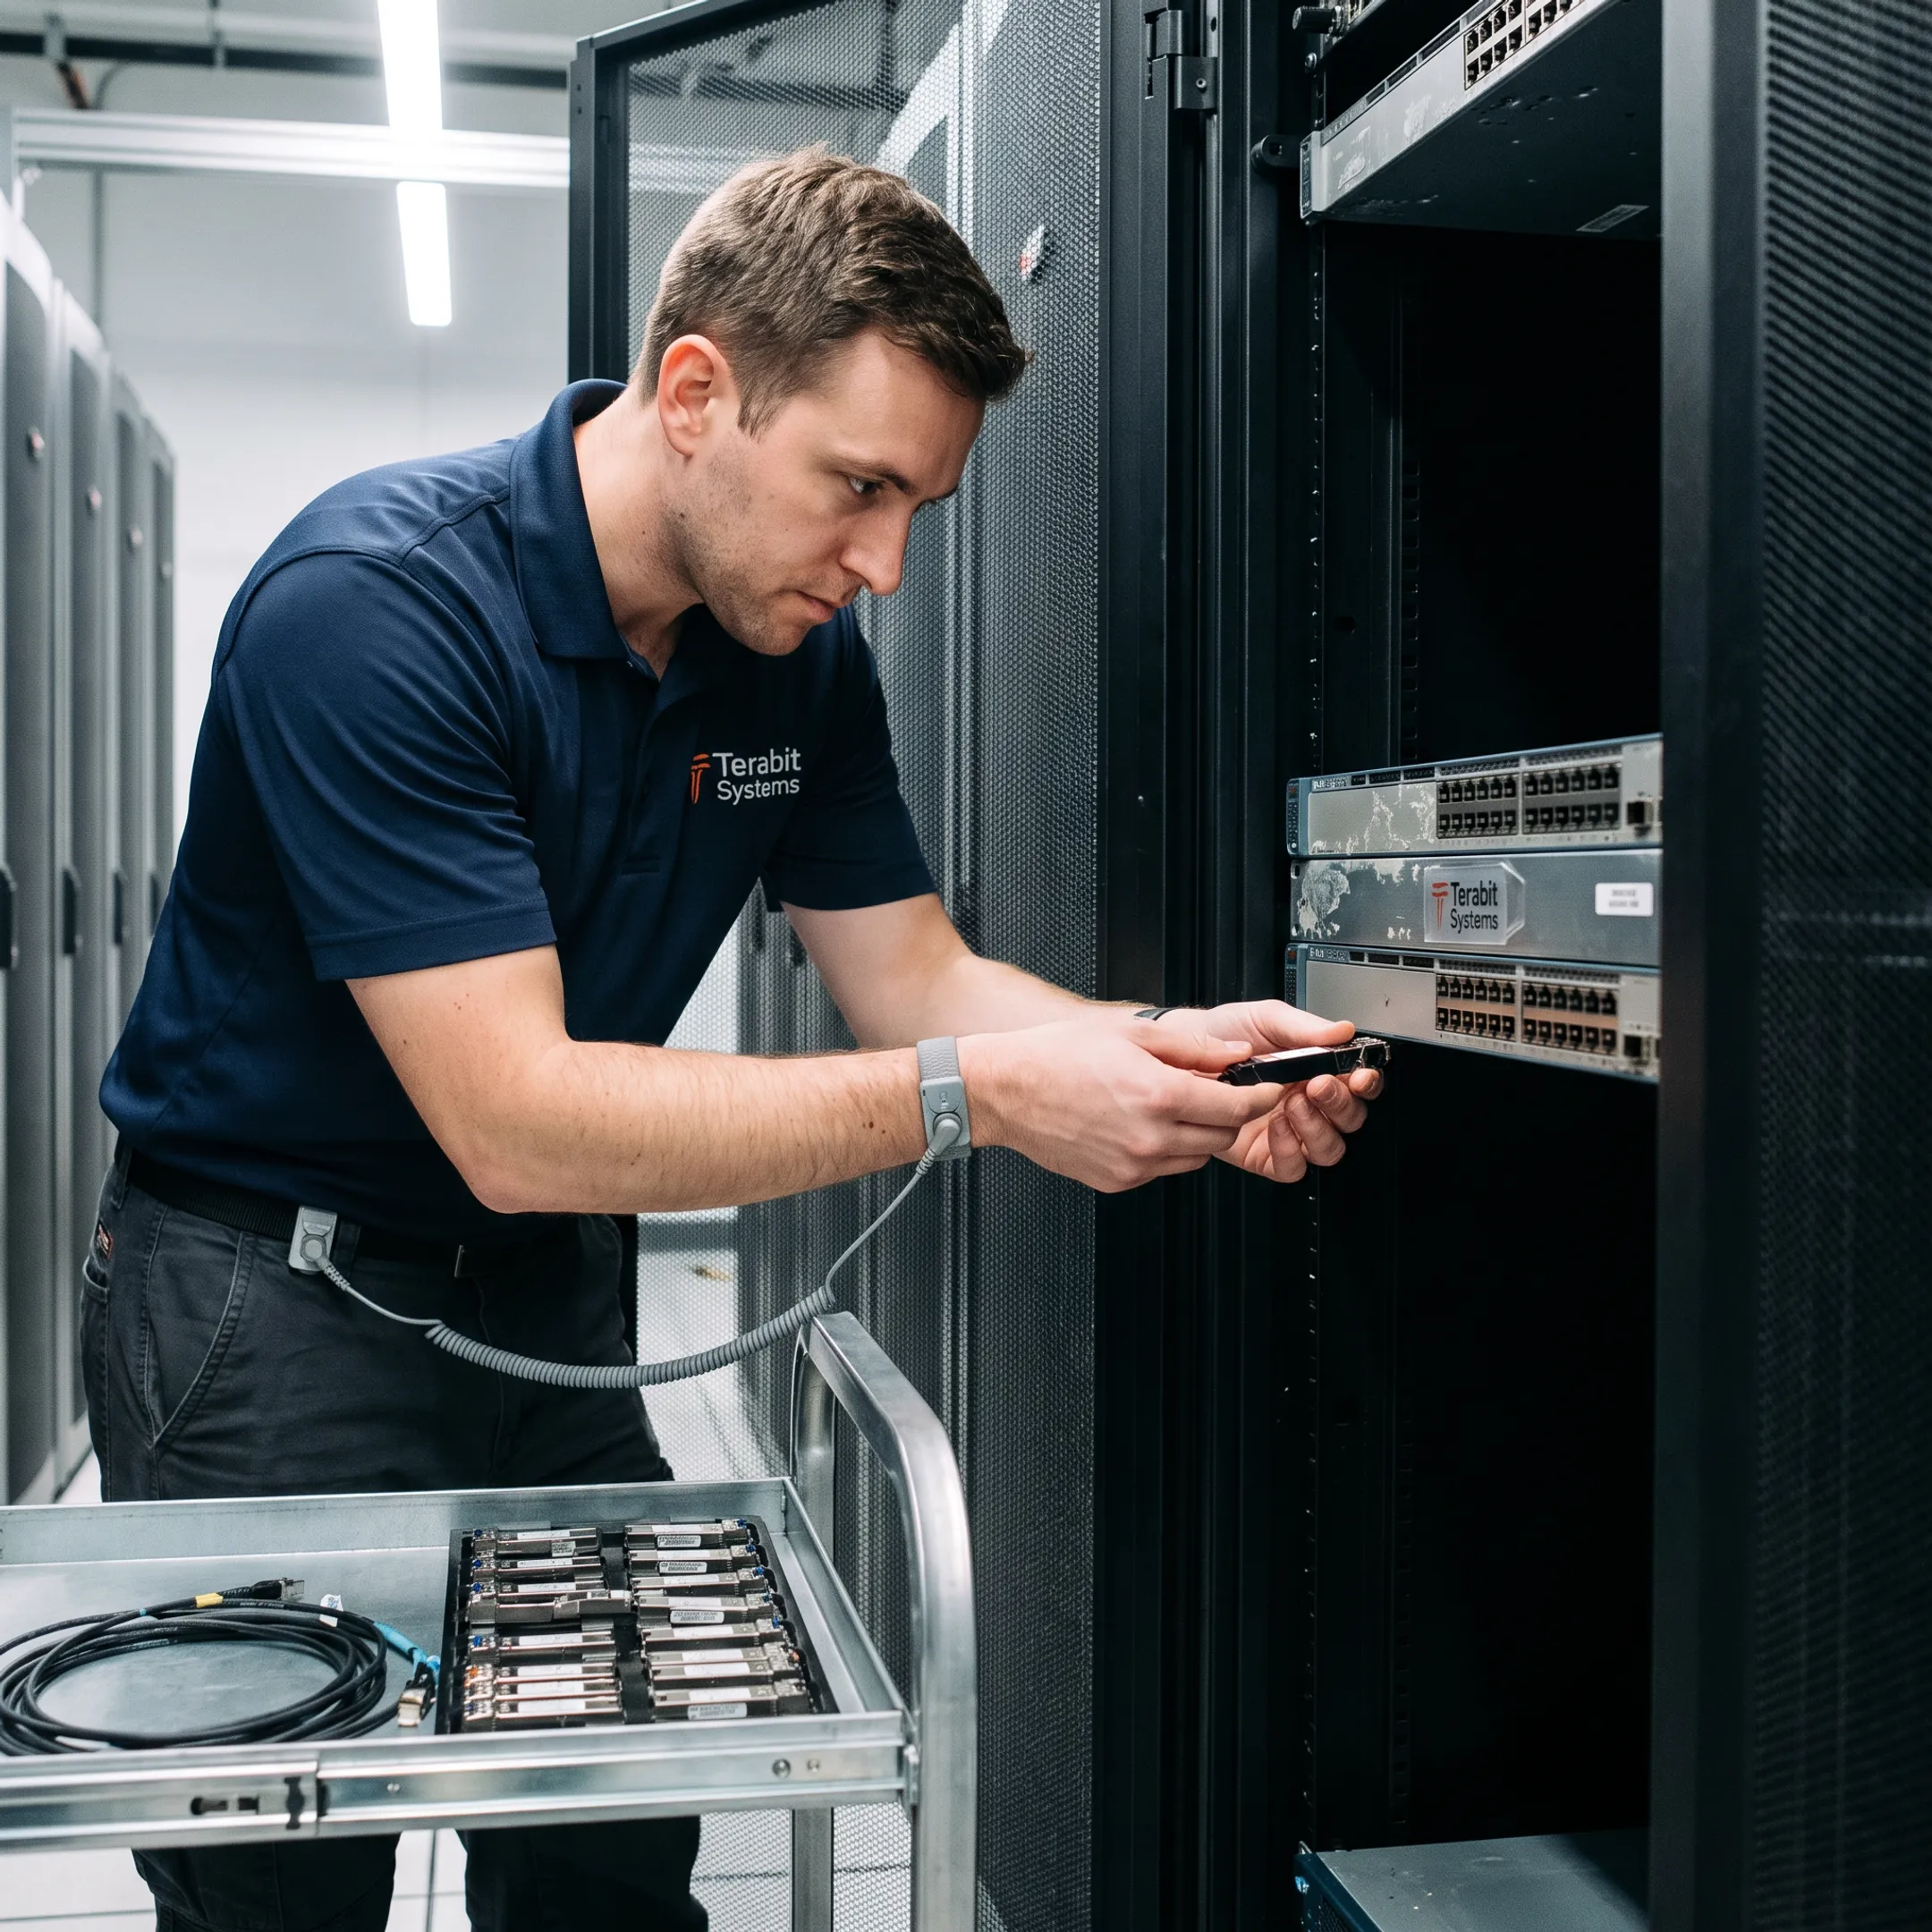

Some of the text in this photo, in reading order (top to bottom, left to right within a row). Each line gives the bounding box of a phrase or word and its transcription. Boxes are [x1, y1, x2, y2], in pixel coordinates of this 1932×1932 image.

[712, 747, 801, 777] Terabit
[716, 778, 801, 805] Systems
[1450, 880, 1498, 906] Terabit
[1450, 908, 1498, 934] Systems
